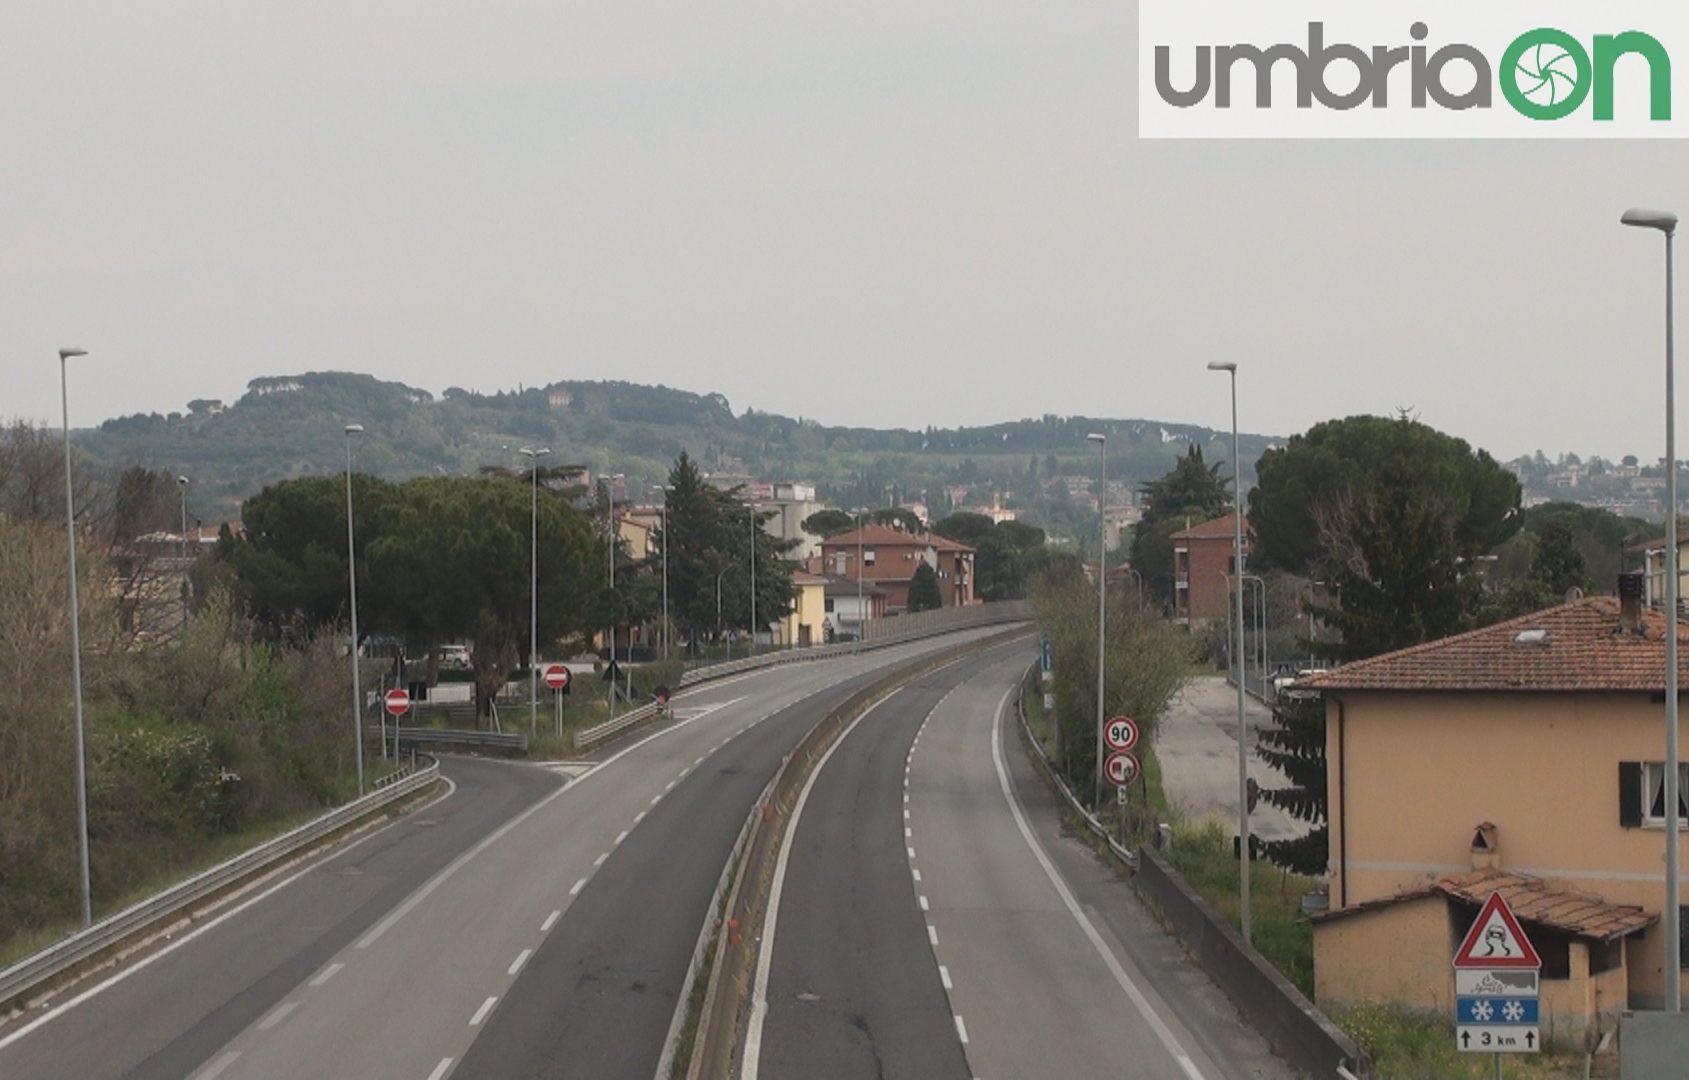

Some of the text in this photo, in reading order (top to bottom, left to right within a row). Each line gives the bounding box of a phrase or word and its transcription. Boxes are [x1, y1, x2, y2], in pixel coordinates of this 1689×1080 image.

[1111, 726, 1130, 742] 90
[1481, 1031, 1516, 1046] 3 km
